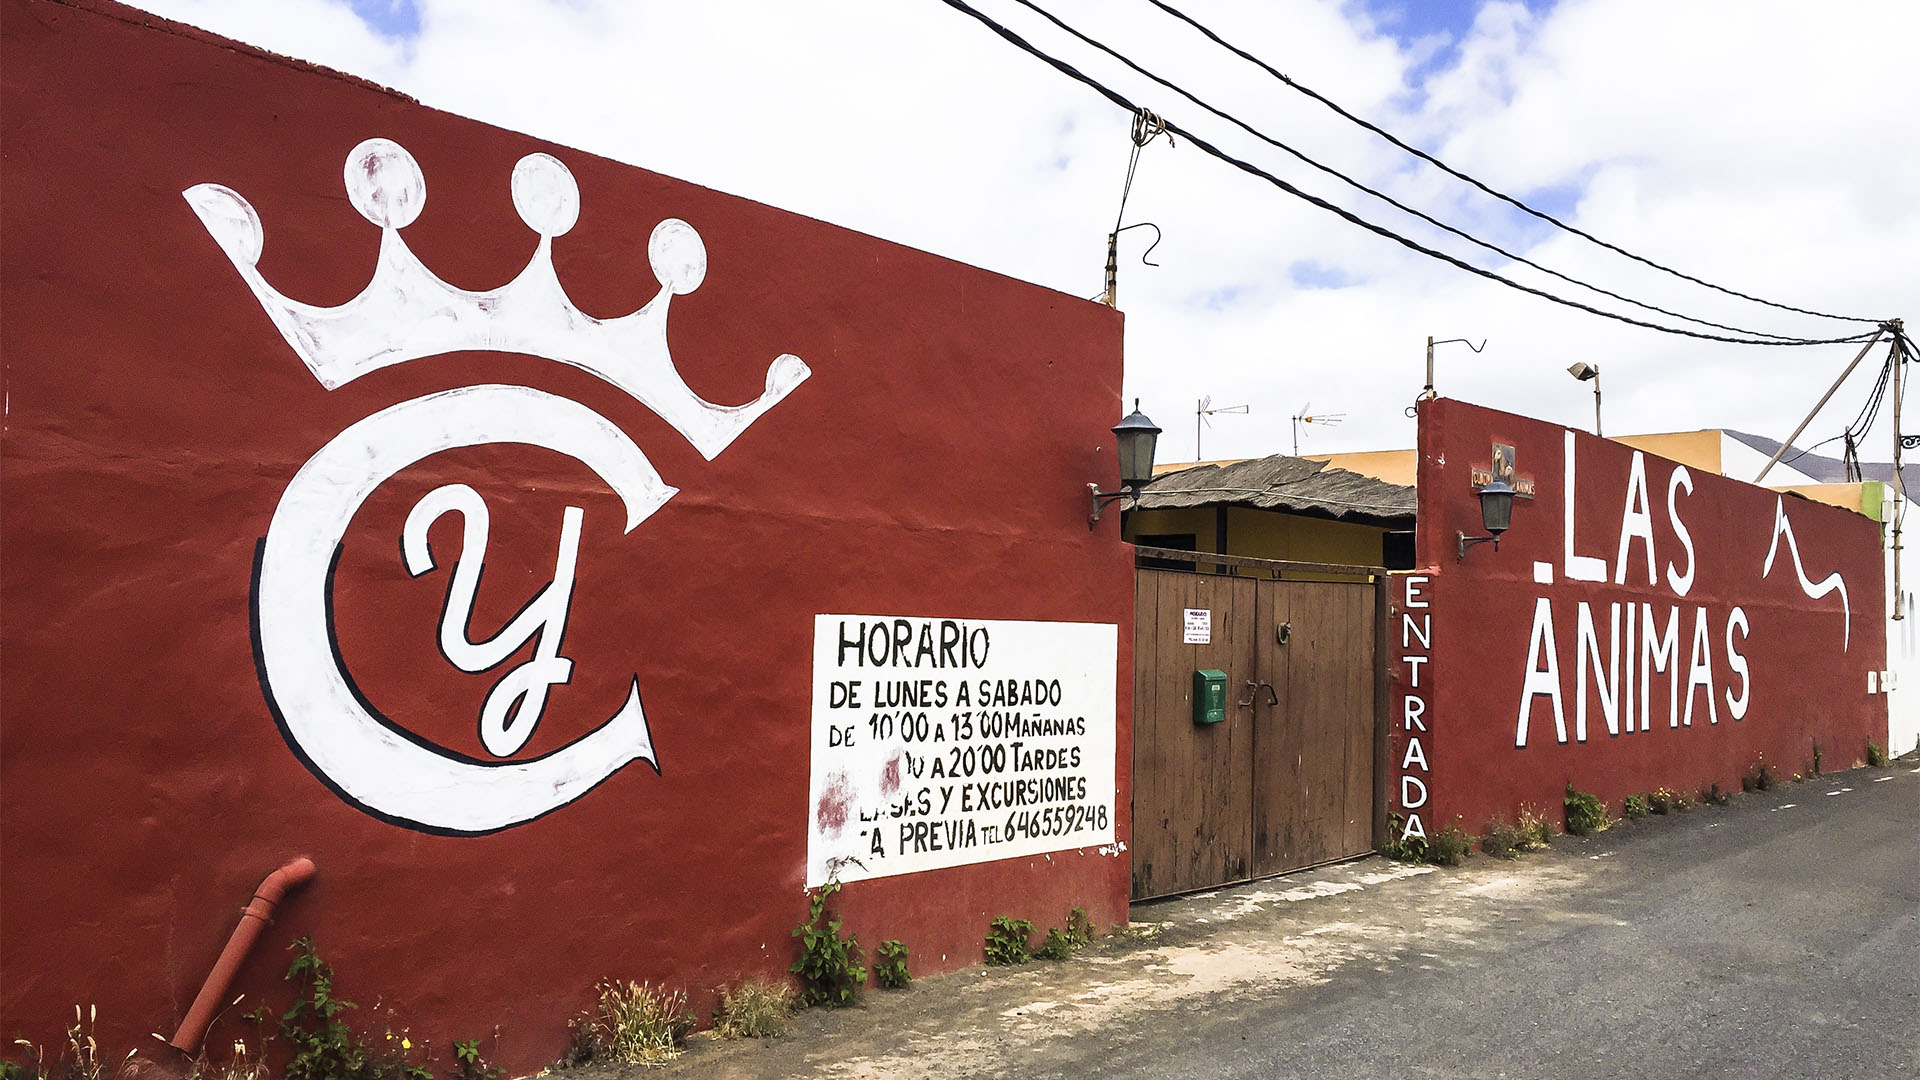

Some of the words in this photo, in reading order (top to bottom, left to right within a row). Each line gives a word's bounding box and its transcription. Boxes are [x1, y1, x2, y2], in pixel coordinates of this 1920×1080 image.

[1564, 429, 1695, 597] LAS
[838, 619, 990, 669] HORARIO
[830, 681, 862, 709] DE
[874, 680, 948, 708] LUNES
[956, 681, 971, 707] A
[978, 679, 1062, 707] SABADO
[1401, 576, 1431, 848] ENTRADA
[829, 725, 855, 747] DE
[934, 723, 945, 742] A
[931, 757, 945, 779] A
[1011, 742, 1081, 772] TARDES
[940, 786, 954, 815] Y
[962, 776, 1087, 812] EXCURSIONES
[899, 821, 977, 855] PREVIA
[982, 825, 1003, 845] TEL
[1004, 804, 1108, 842] 646559248
